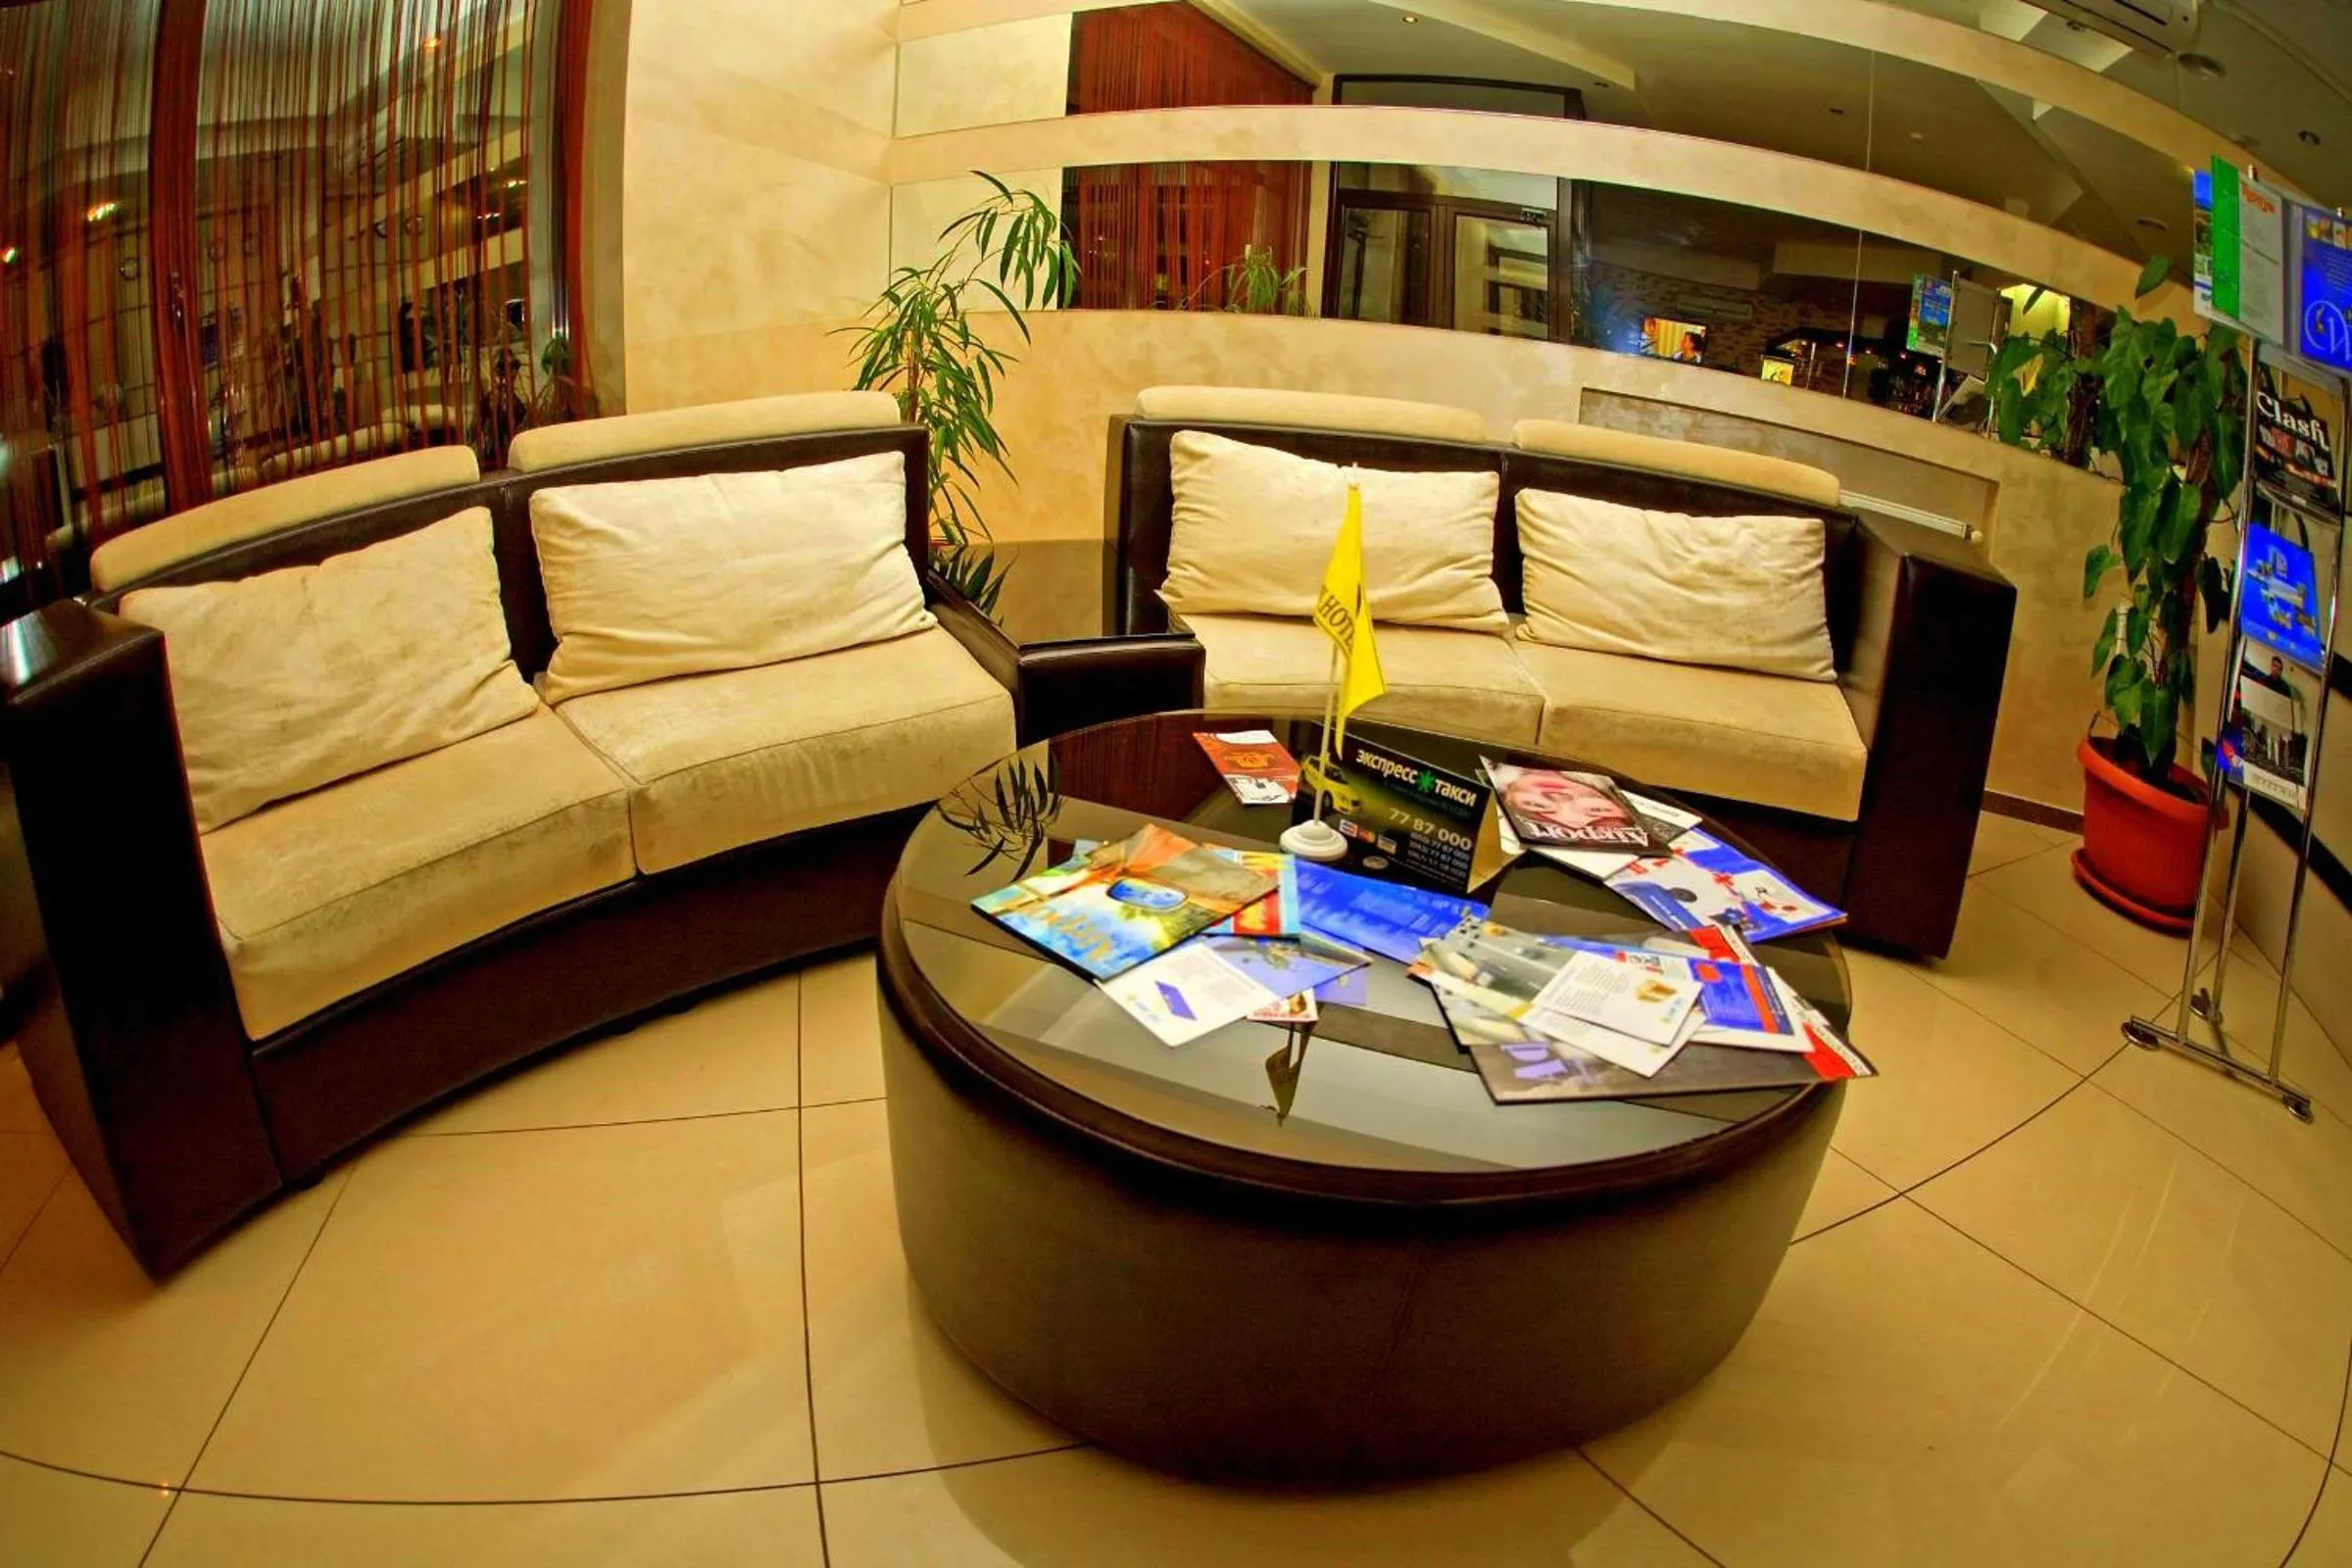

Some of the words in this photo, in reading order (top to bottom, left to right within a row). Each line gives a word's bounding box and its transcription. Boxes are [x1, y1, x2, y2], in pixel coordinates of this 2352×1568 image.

[1389, 807, 1410, 824] 77
[1412, 817, 1436, 834] 87
[1438, 828, 1472, 851] 000
